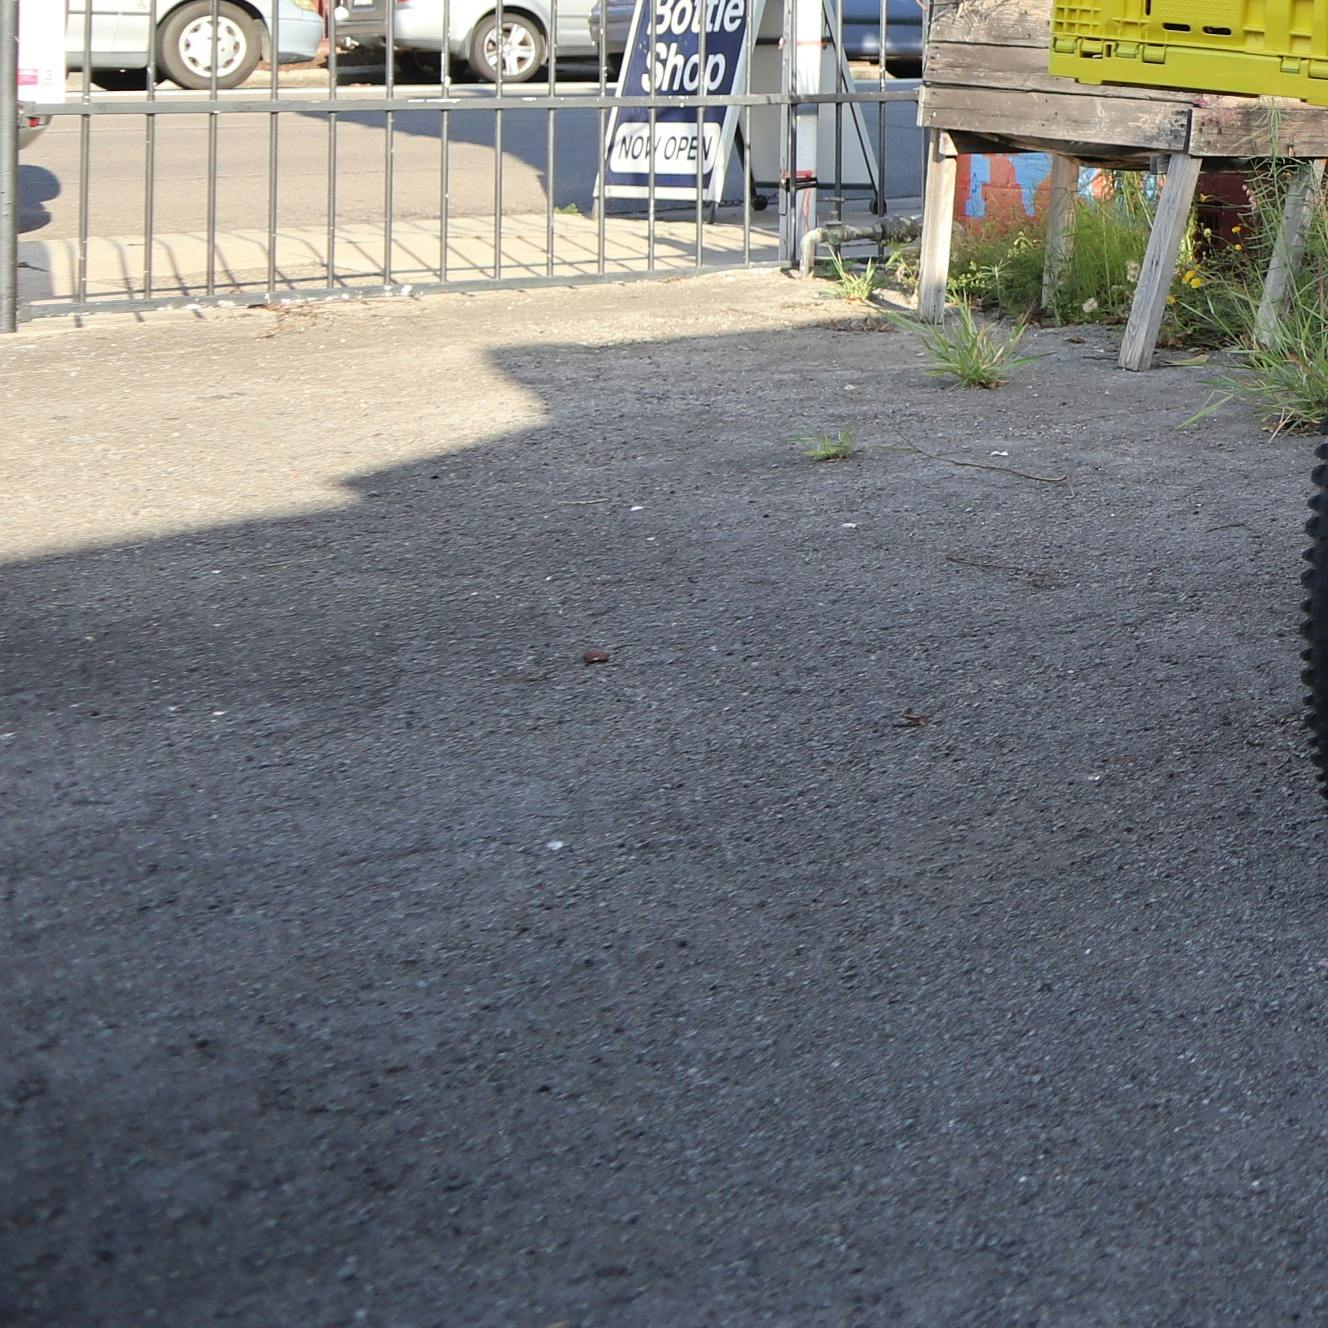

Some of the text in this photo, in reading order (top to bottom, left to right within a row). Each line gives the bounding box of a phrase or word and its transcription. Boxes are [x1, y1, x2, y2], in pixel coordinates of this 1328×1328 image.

[641, 42, 726, 96] Shop
[618, 135, 713, 161] NOW OPEN
